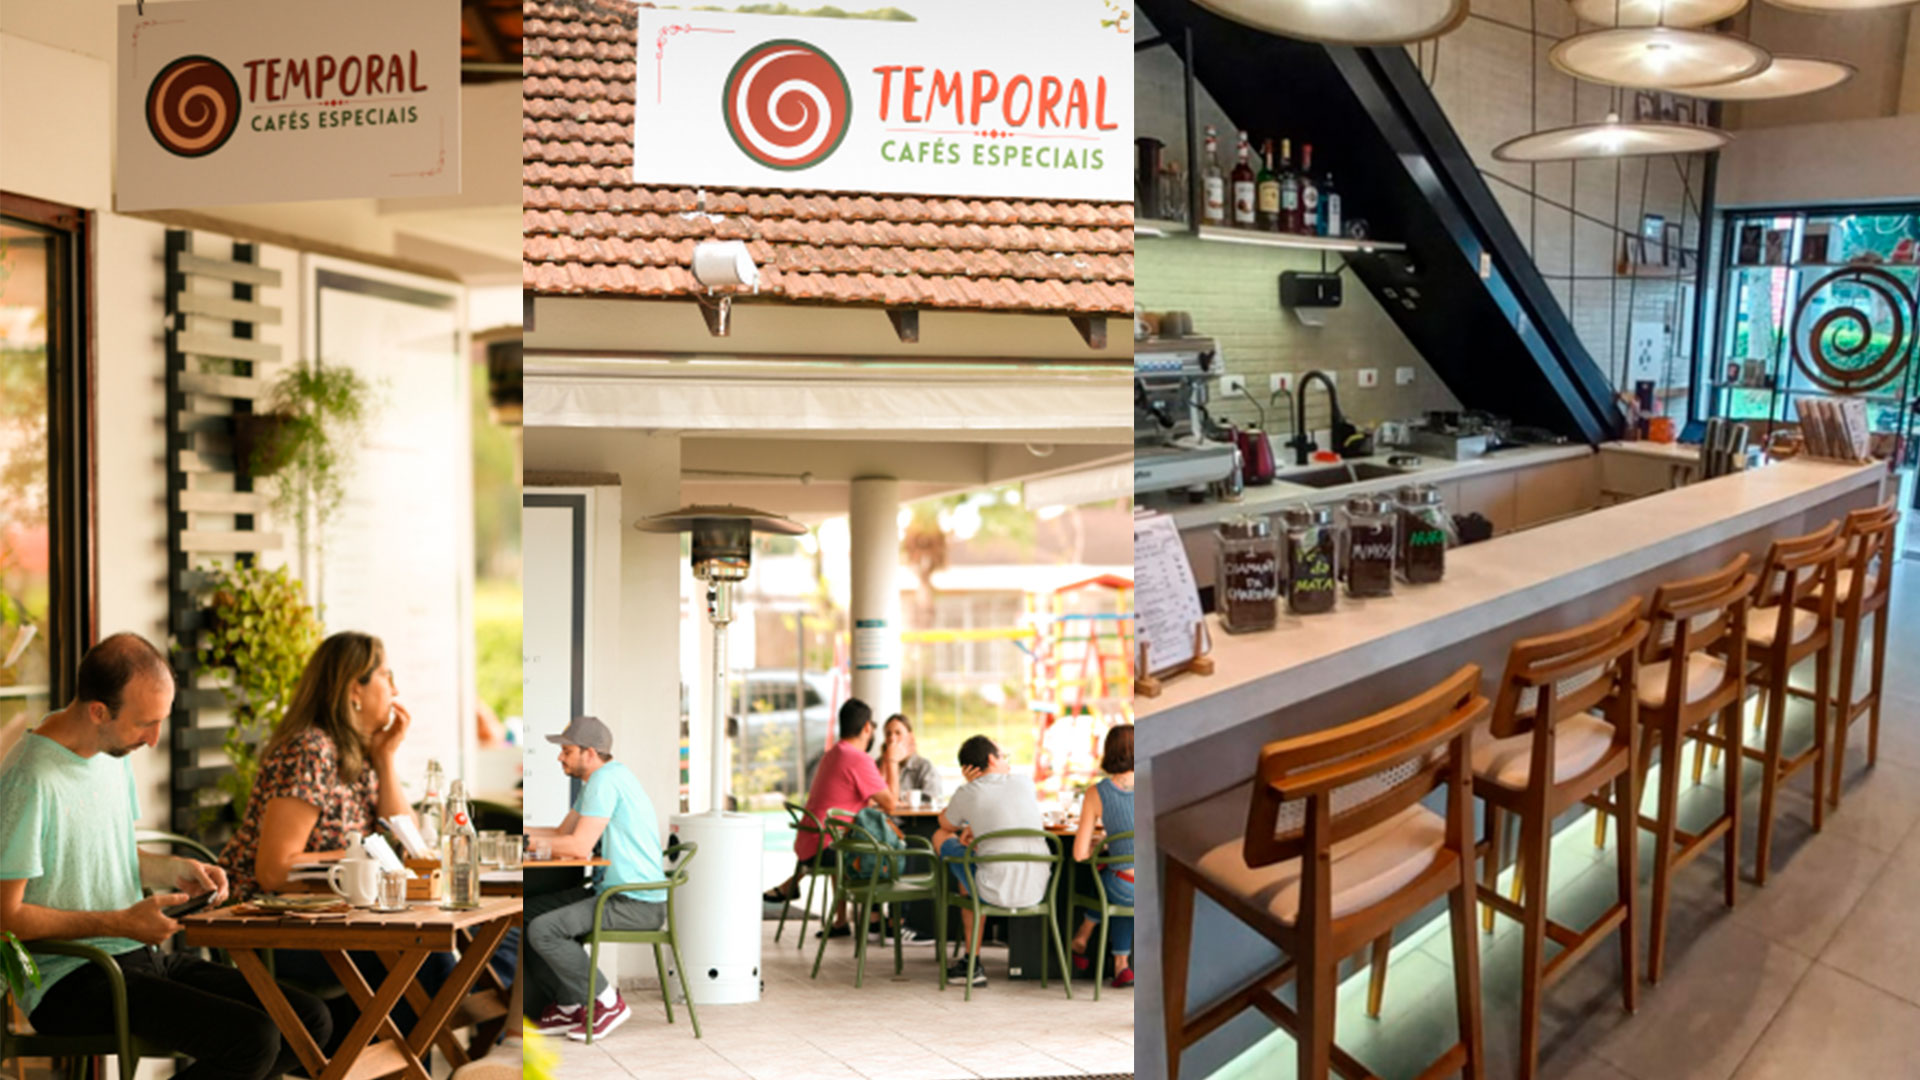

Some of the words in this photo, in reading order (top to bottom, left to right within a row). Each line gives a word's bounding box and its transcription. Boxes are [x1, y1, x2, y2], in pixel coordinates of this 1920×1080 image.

[243, 50, 428, 103] TEMPORAL
[251, 111, 310, 132] CAFÉS
[318, 106, 419, 129] ESPECIAIS
[872, 65, 1119, 131] TEMPORAL
[880, 138, 961, 165] CAFÉS
[972, 144, 1105, 170] ESPECIAIS
